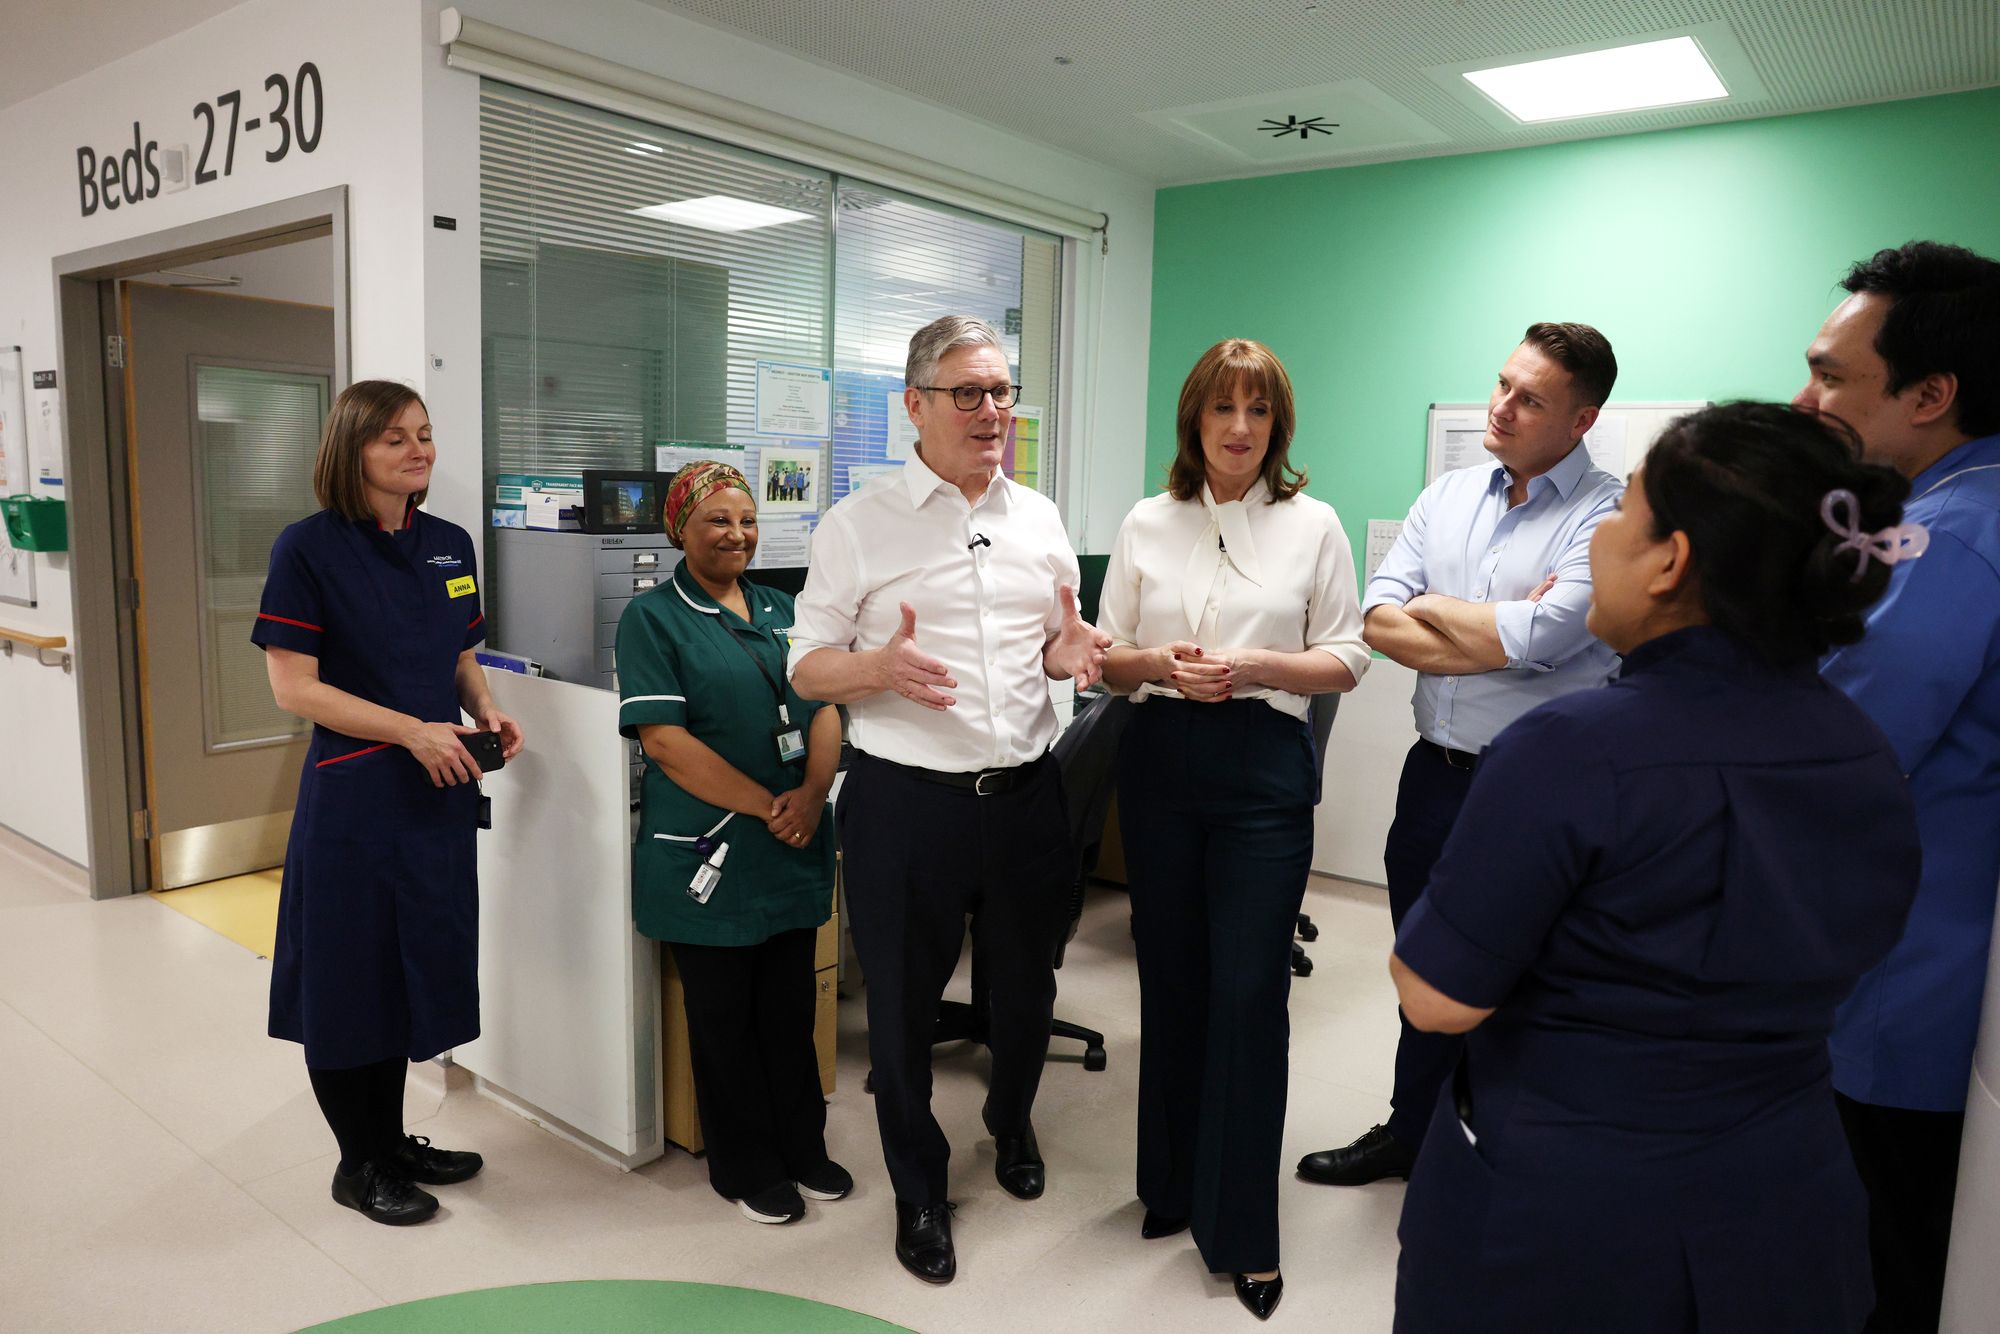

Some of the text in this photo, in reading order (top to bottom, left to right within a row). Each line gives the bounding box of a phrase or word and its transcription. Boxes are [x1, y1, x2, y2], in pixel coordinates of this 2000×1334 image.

[76, 61, 324, 218] Beds 27-30
[453, 583, 472, 593] ANNA
